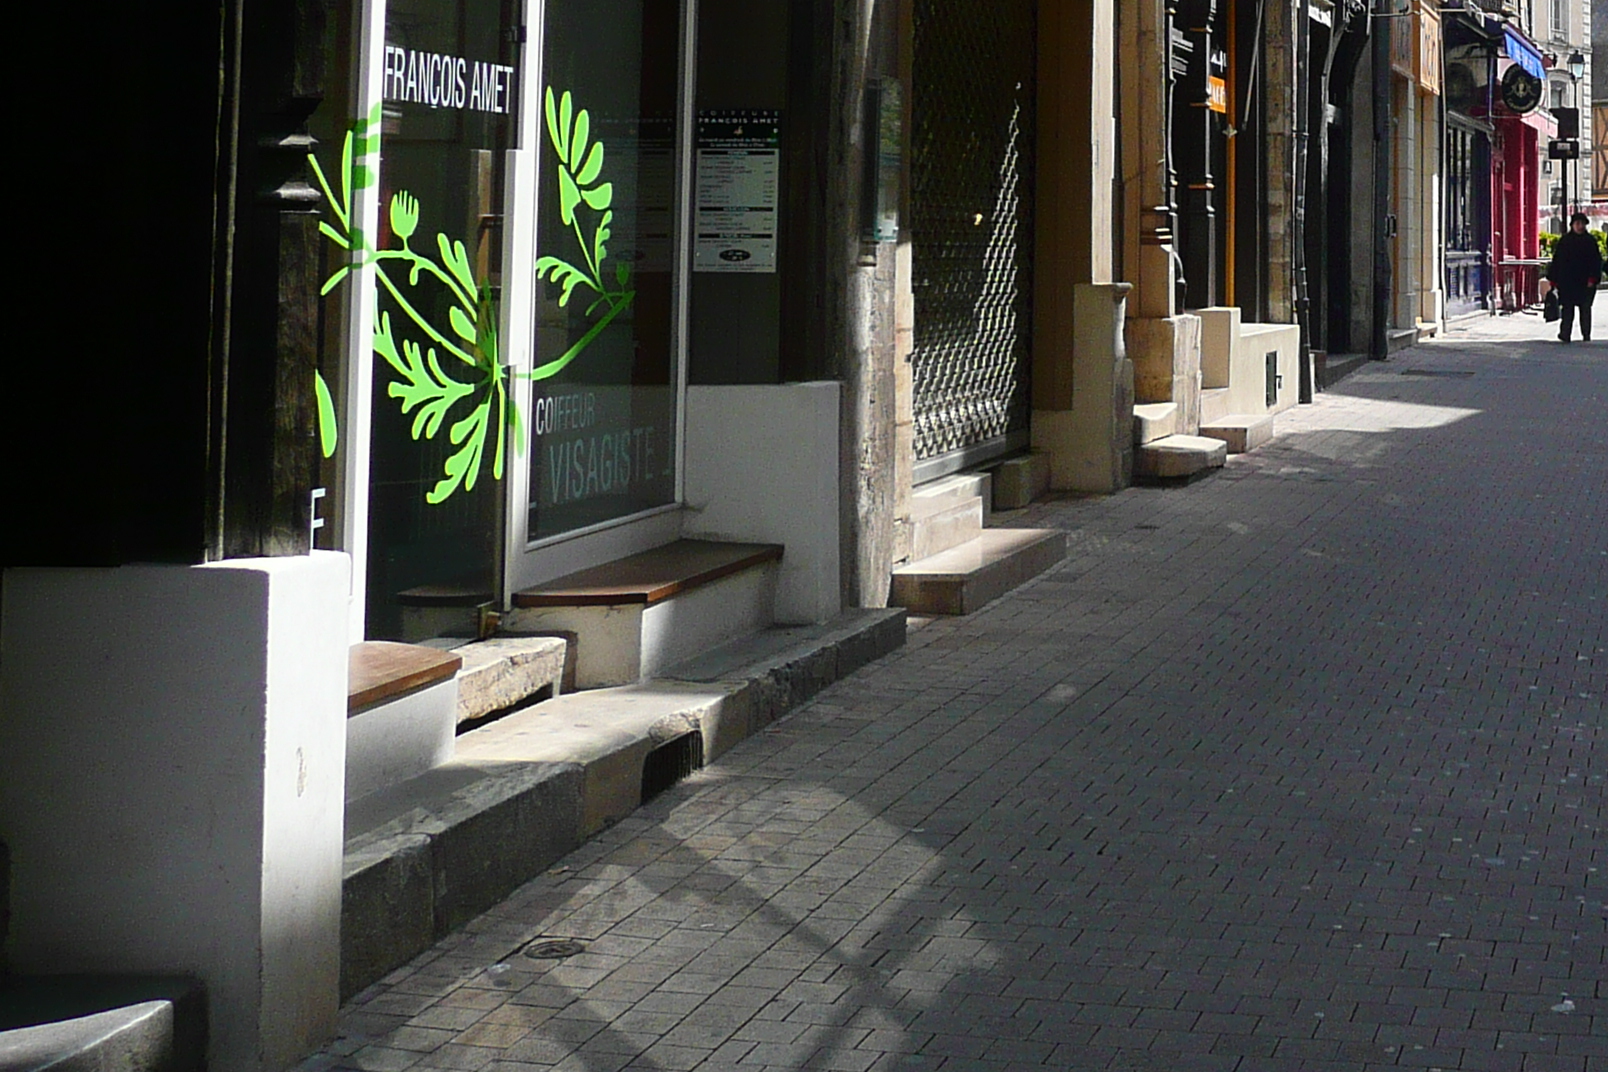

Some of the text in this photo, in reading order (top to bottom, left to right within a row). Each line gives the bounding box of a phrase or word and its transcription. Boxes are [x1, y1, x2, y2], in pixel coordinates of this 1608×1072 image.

[383, 45, 514, 114] FRANÇOIS AMET
[535, 392, 596, 435] COIFFEUR
[549, 426, 656, 504] VISAGISTE
